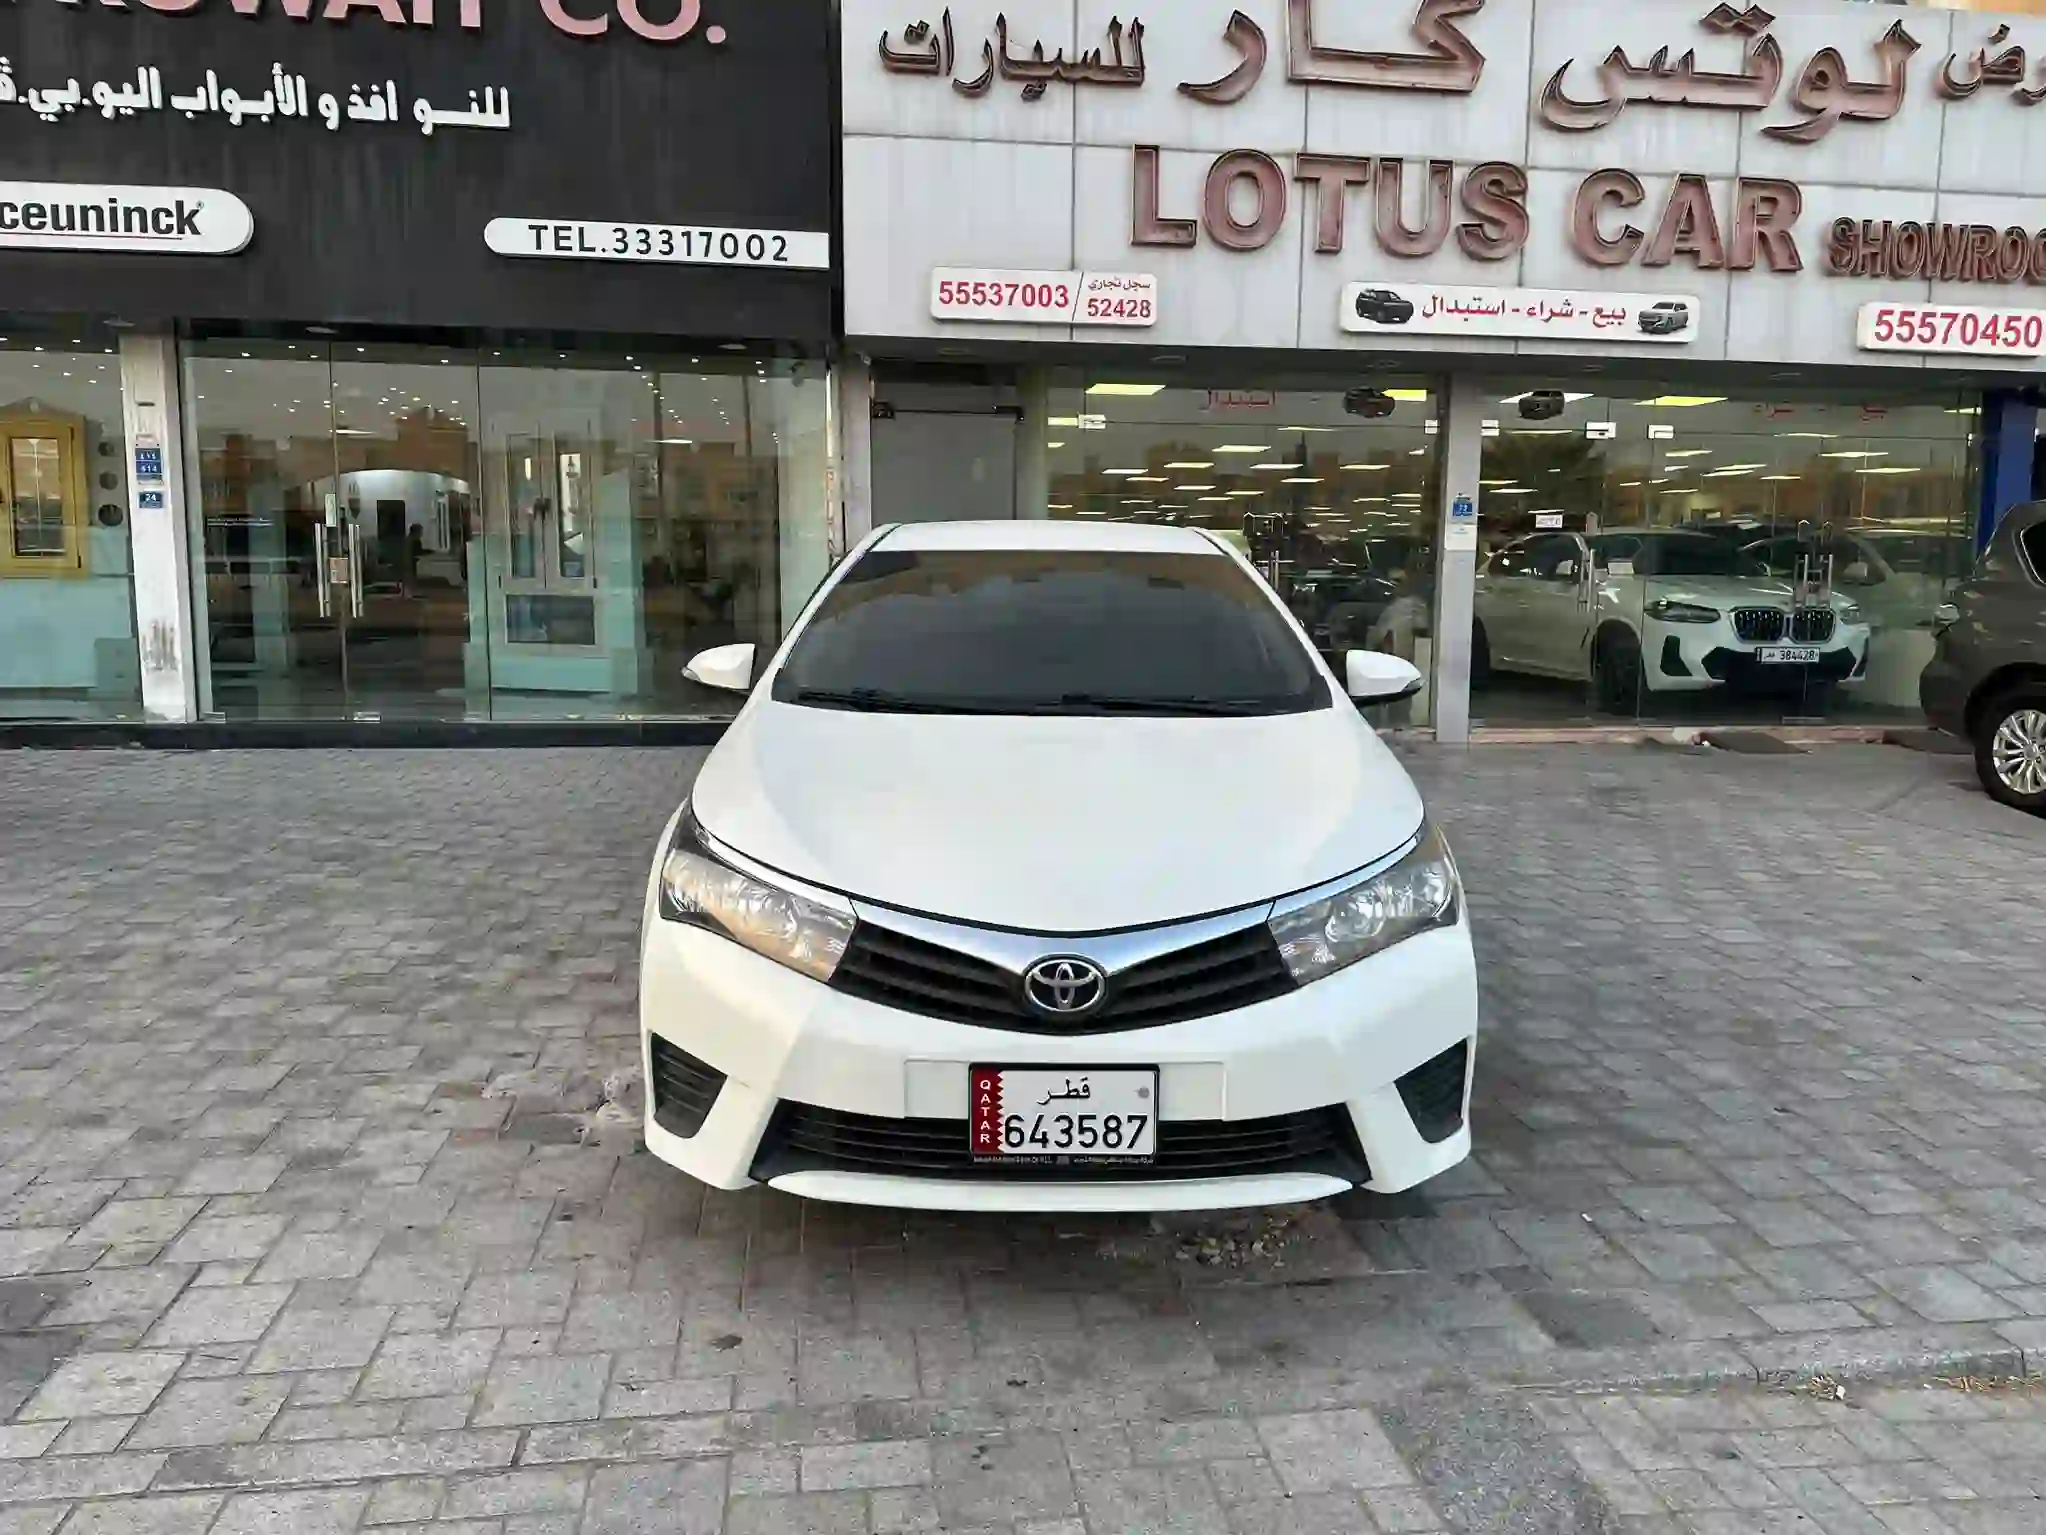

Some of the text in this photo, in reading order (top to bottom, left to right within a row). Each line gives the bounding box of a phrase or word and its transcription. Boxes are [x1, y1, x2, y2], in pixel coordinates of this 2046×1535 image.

[877, 6, 1145, 99] للسيارات
[1176, 0, 1487, 103] كار
[1539, 3, 1923, 143] لوتس
[170, 62, 308, 126] الأبواب
[1131, 143, 1530, 262] LOTUS
[1571, 166, 1804, 274] CAR
[528, 224, 788, 262] TEL.33317002
[938, 280, 1069, 308] 55537003
[1123, 278, 1151, 292] سجل
[1087, 298, 1151, 318] 52428
[1422, 292, 1627, 329] بيع شراء استبدال
[1874, 309, 2043, 349] 55570450
[1036, 1075, 1091, 1105] قطر
[979, 1079, 992, 1144] QATAR
[1004, 1113, 1149, 1149] 643587
